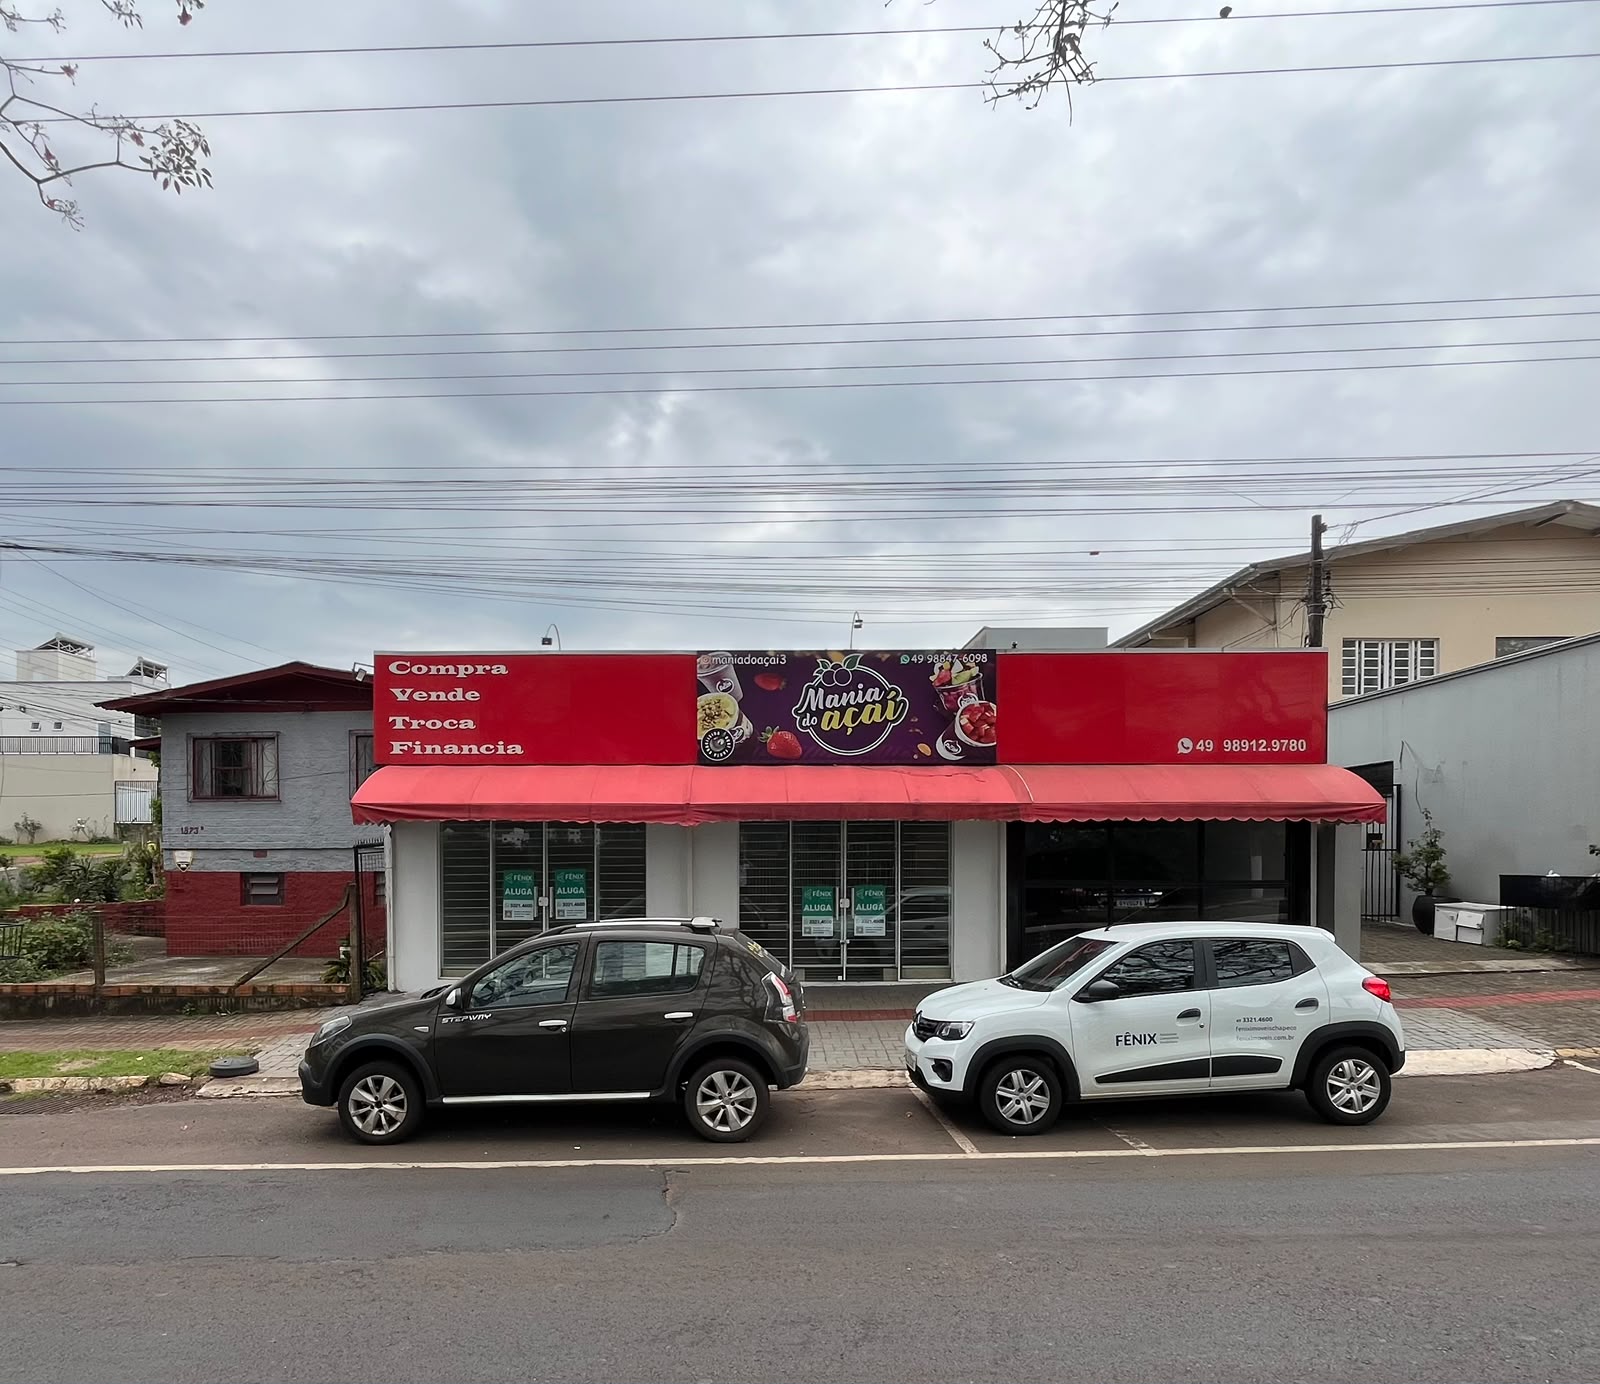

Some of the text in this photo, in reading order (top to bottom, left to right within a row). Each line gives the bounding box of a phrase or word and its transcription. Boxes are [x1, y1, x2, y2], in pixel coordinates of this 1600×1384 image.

[911, 653, 988, 664] 49 98847-6098
[388, 661, 508, 678] Compra
[389, 688, 480, 701] Vende
[798, 683, 884, 713] Mania
[388, 716, 476, 730] Troca
[802, 713, 818, 726] do
[389, 741, 524, 755] Financia
[1196, 739, 1307, 752] 49 98912.9780
[504, 887, 533, 896] ALUGA
[556, 886, 585, 895] ALUGA
[803, 904, 832, 912] ALUGA
[855, 903, 884, 911] ALUGA
[441, 1013, 492, 1024] STEPWAY
[1115, 1031, 1157, 1046] FÊNIX
